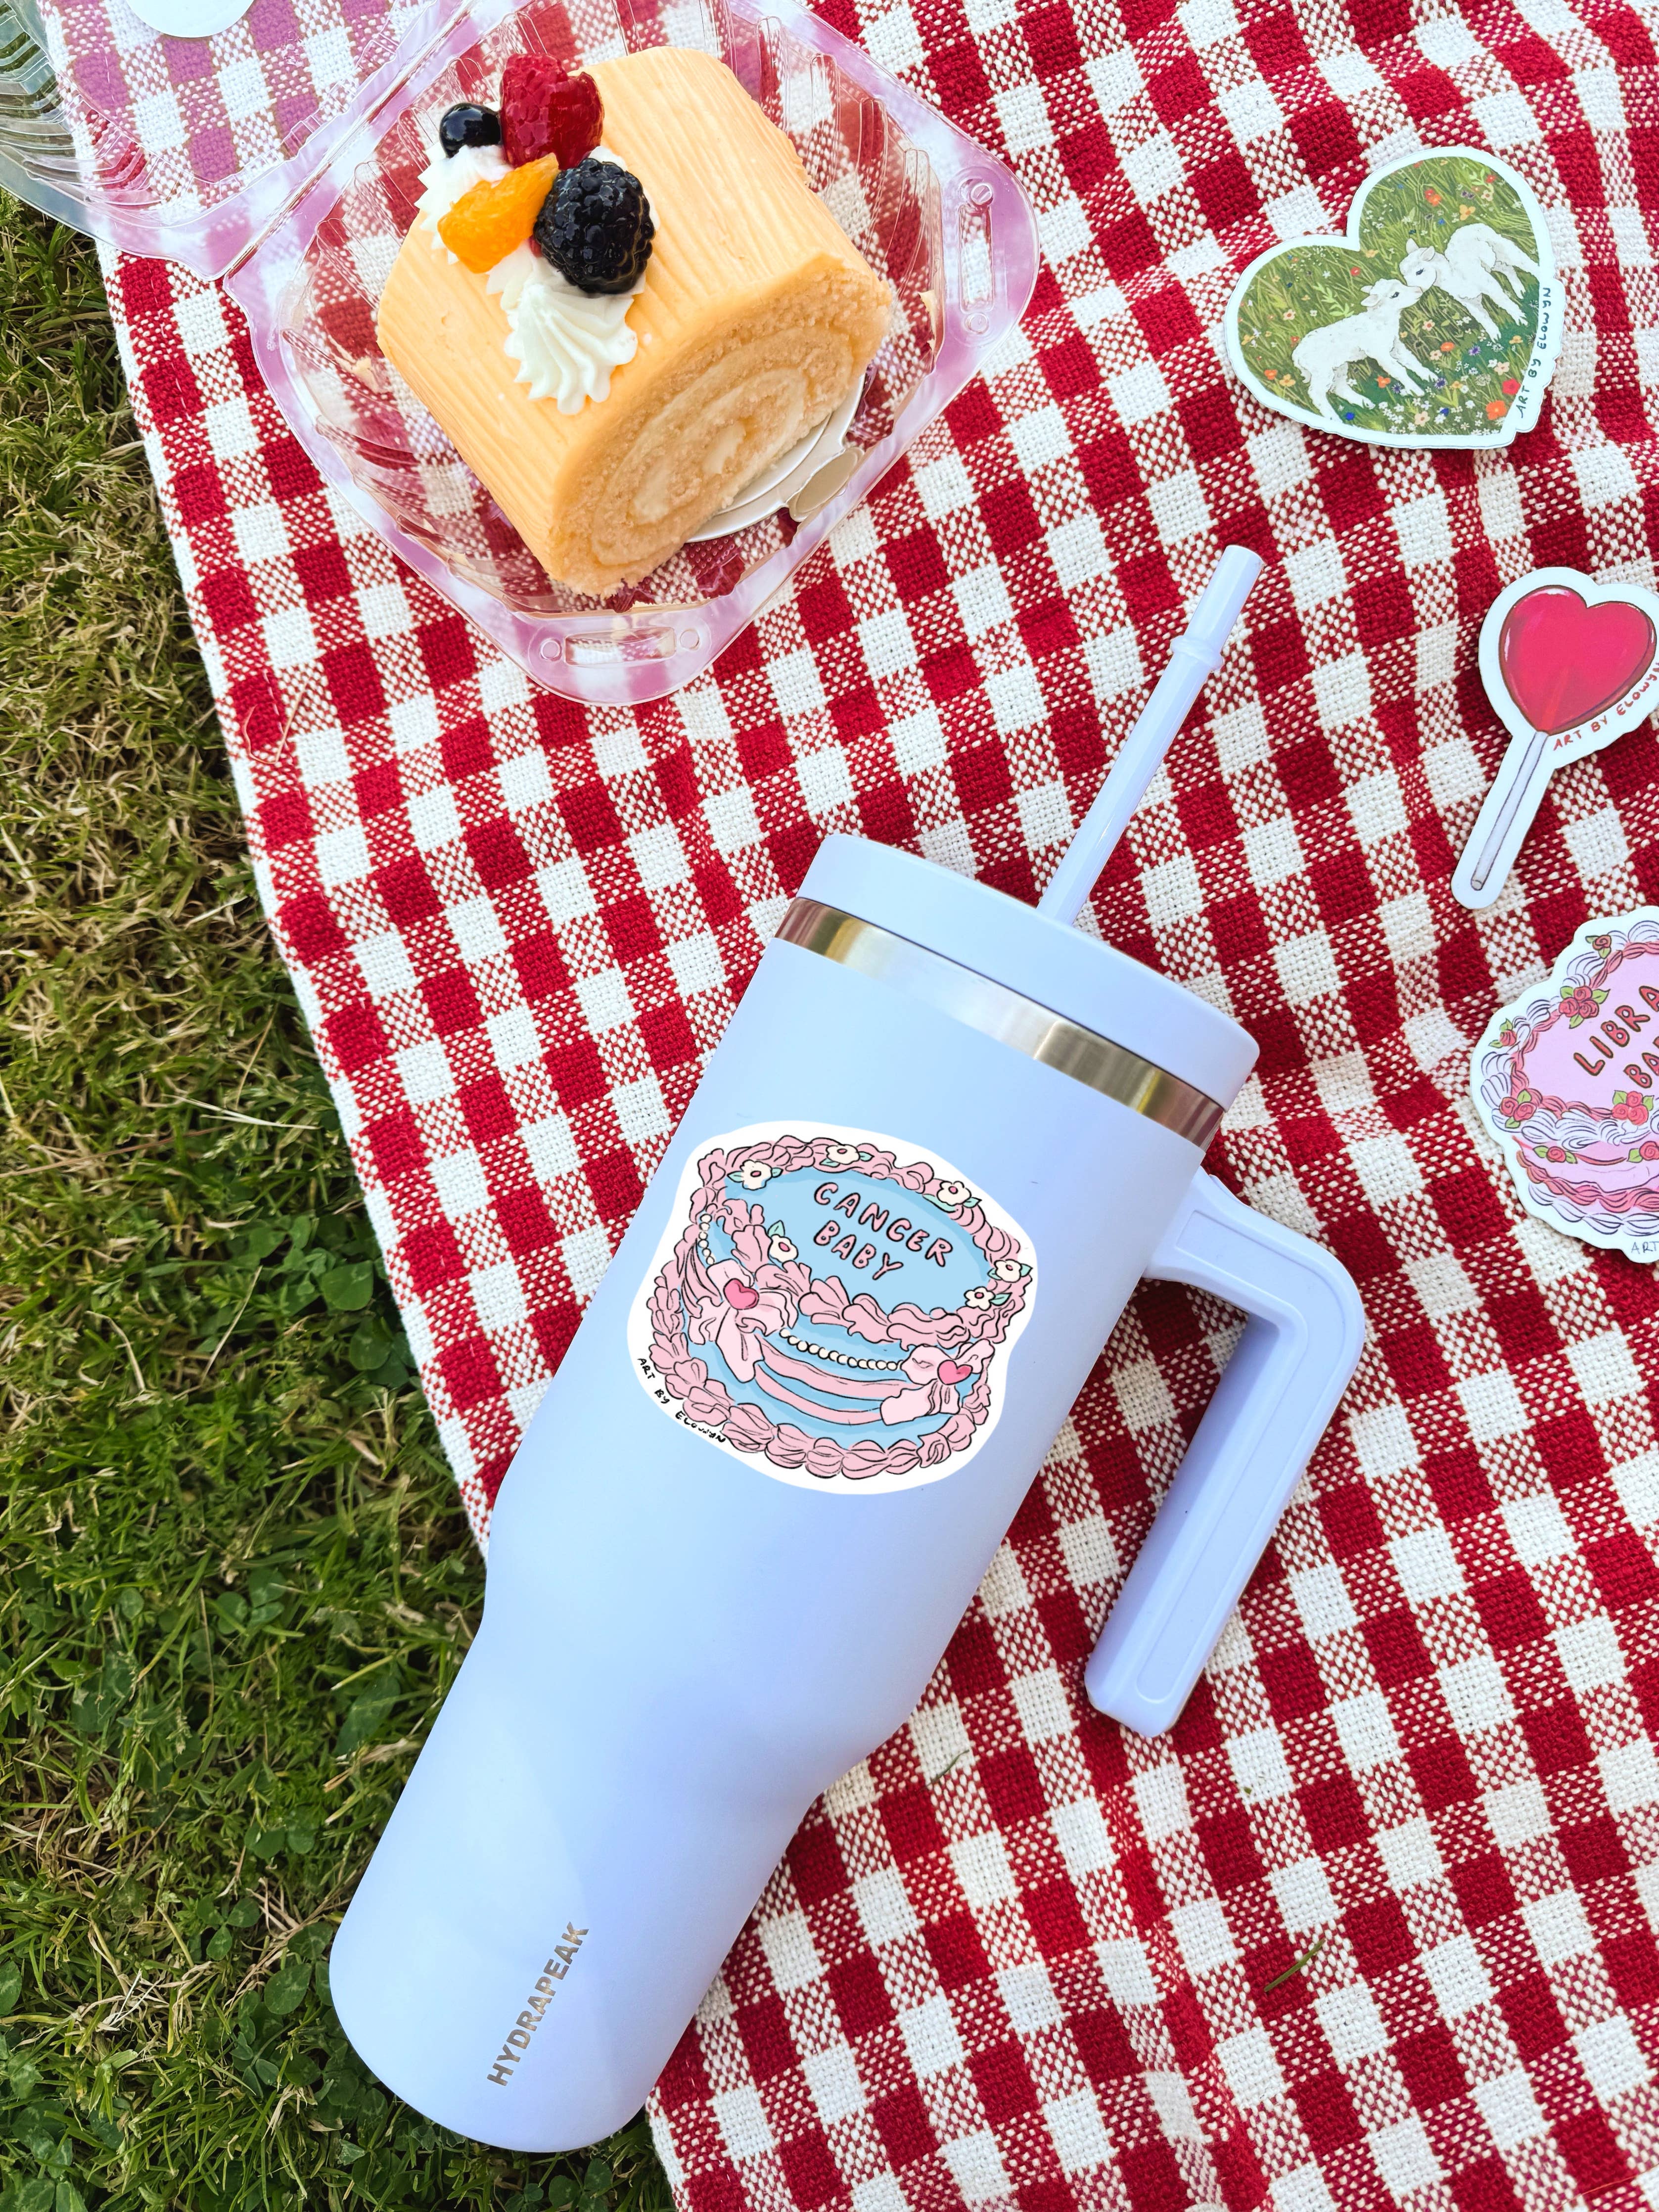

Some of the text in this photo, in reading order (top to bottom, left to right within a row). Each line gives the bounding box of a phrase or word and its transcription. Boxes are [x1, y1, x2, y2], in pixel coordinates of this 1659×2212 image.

[1516, 385, 1530, 418] ART
[1537, 287, 1552, 349] ELOWYN
[1553, 730, 1581, 751] ART
[1591, 715, 1607, 732] BY
[813, 1220, 904, 1280] BABY
[814, 1182, 953, 1267] CANCER
[1631, 1242, 1659, 1254] ART
[637, 1358, 655, 1379] ART
[487, 1921, 589, 2086] HYDRAPEAK
